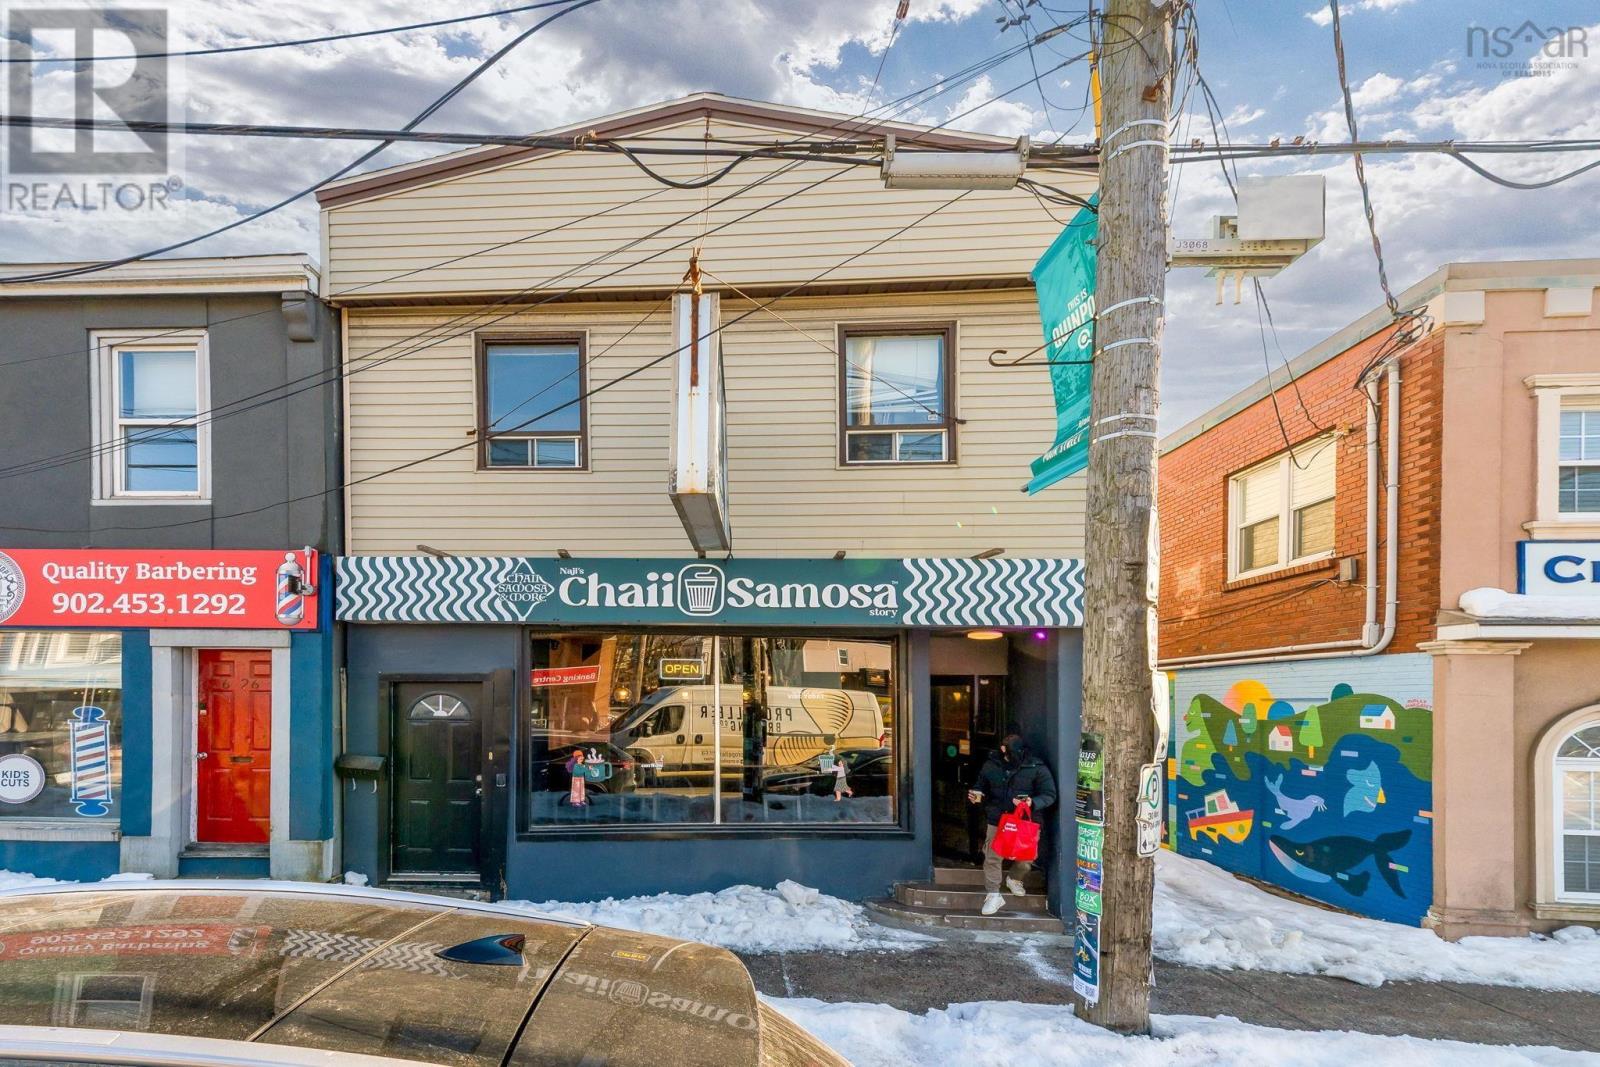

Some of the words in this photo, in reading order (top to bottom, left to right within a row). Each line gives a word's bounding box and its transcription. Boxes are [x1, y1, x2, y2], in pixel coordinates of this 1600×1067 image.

[42, 561, 129, 584] Quality
[135, 562, 257, 585] Barbering
[560, 567, 585, 575] Naji's
[498, 584, 548, 593] SAMOSA
[558, 572, 675, 607] Chaii
[727, 577, 899, 609] Samosa
[510, 592, 547, 602] MORE
[52, 593, 246, 615] 902.453.1292
[869, 608, 898, 618] story
[665, 664, 699, 674] OPEN
[1, 770, 29, 778] KID'S
[1, 779, 29, 787] CUTS
